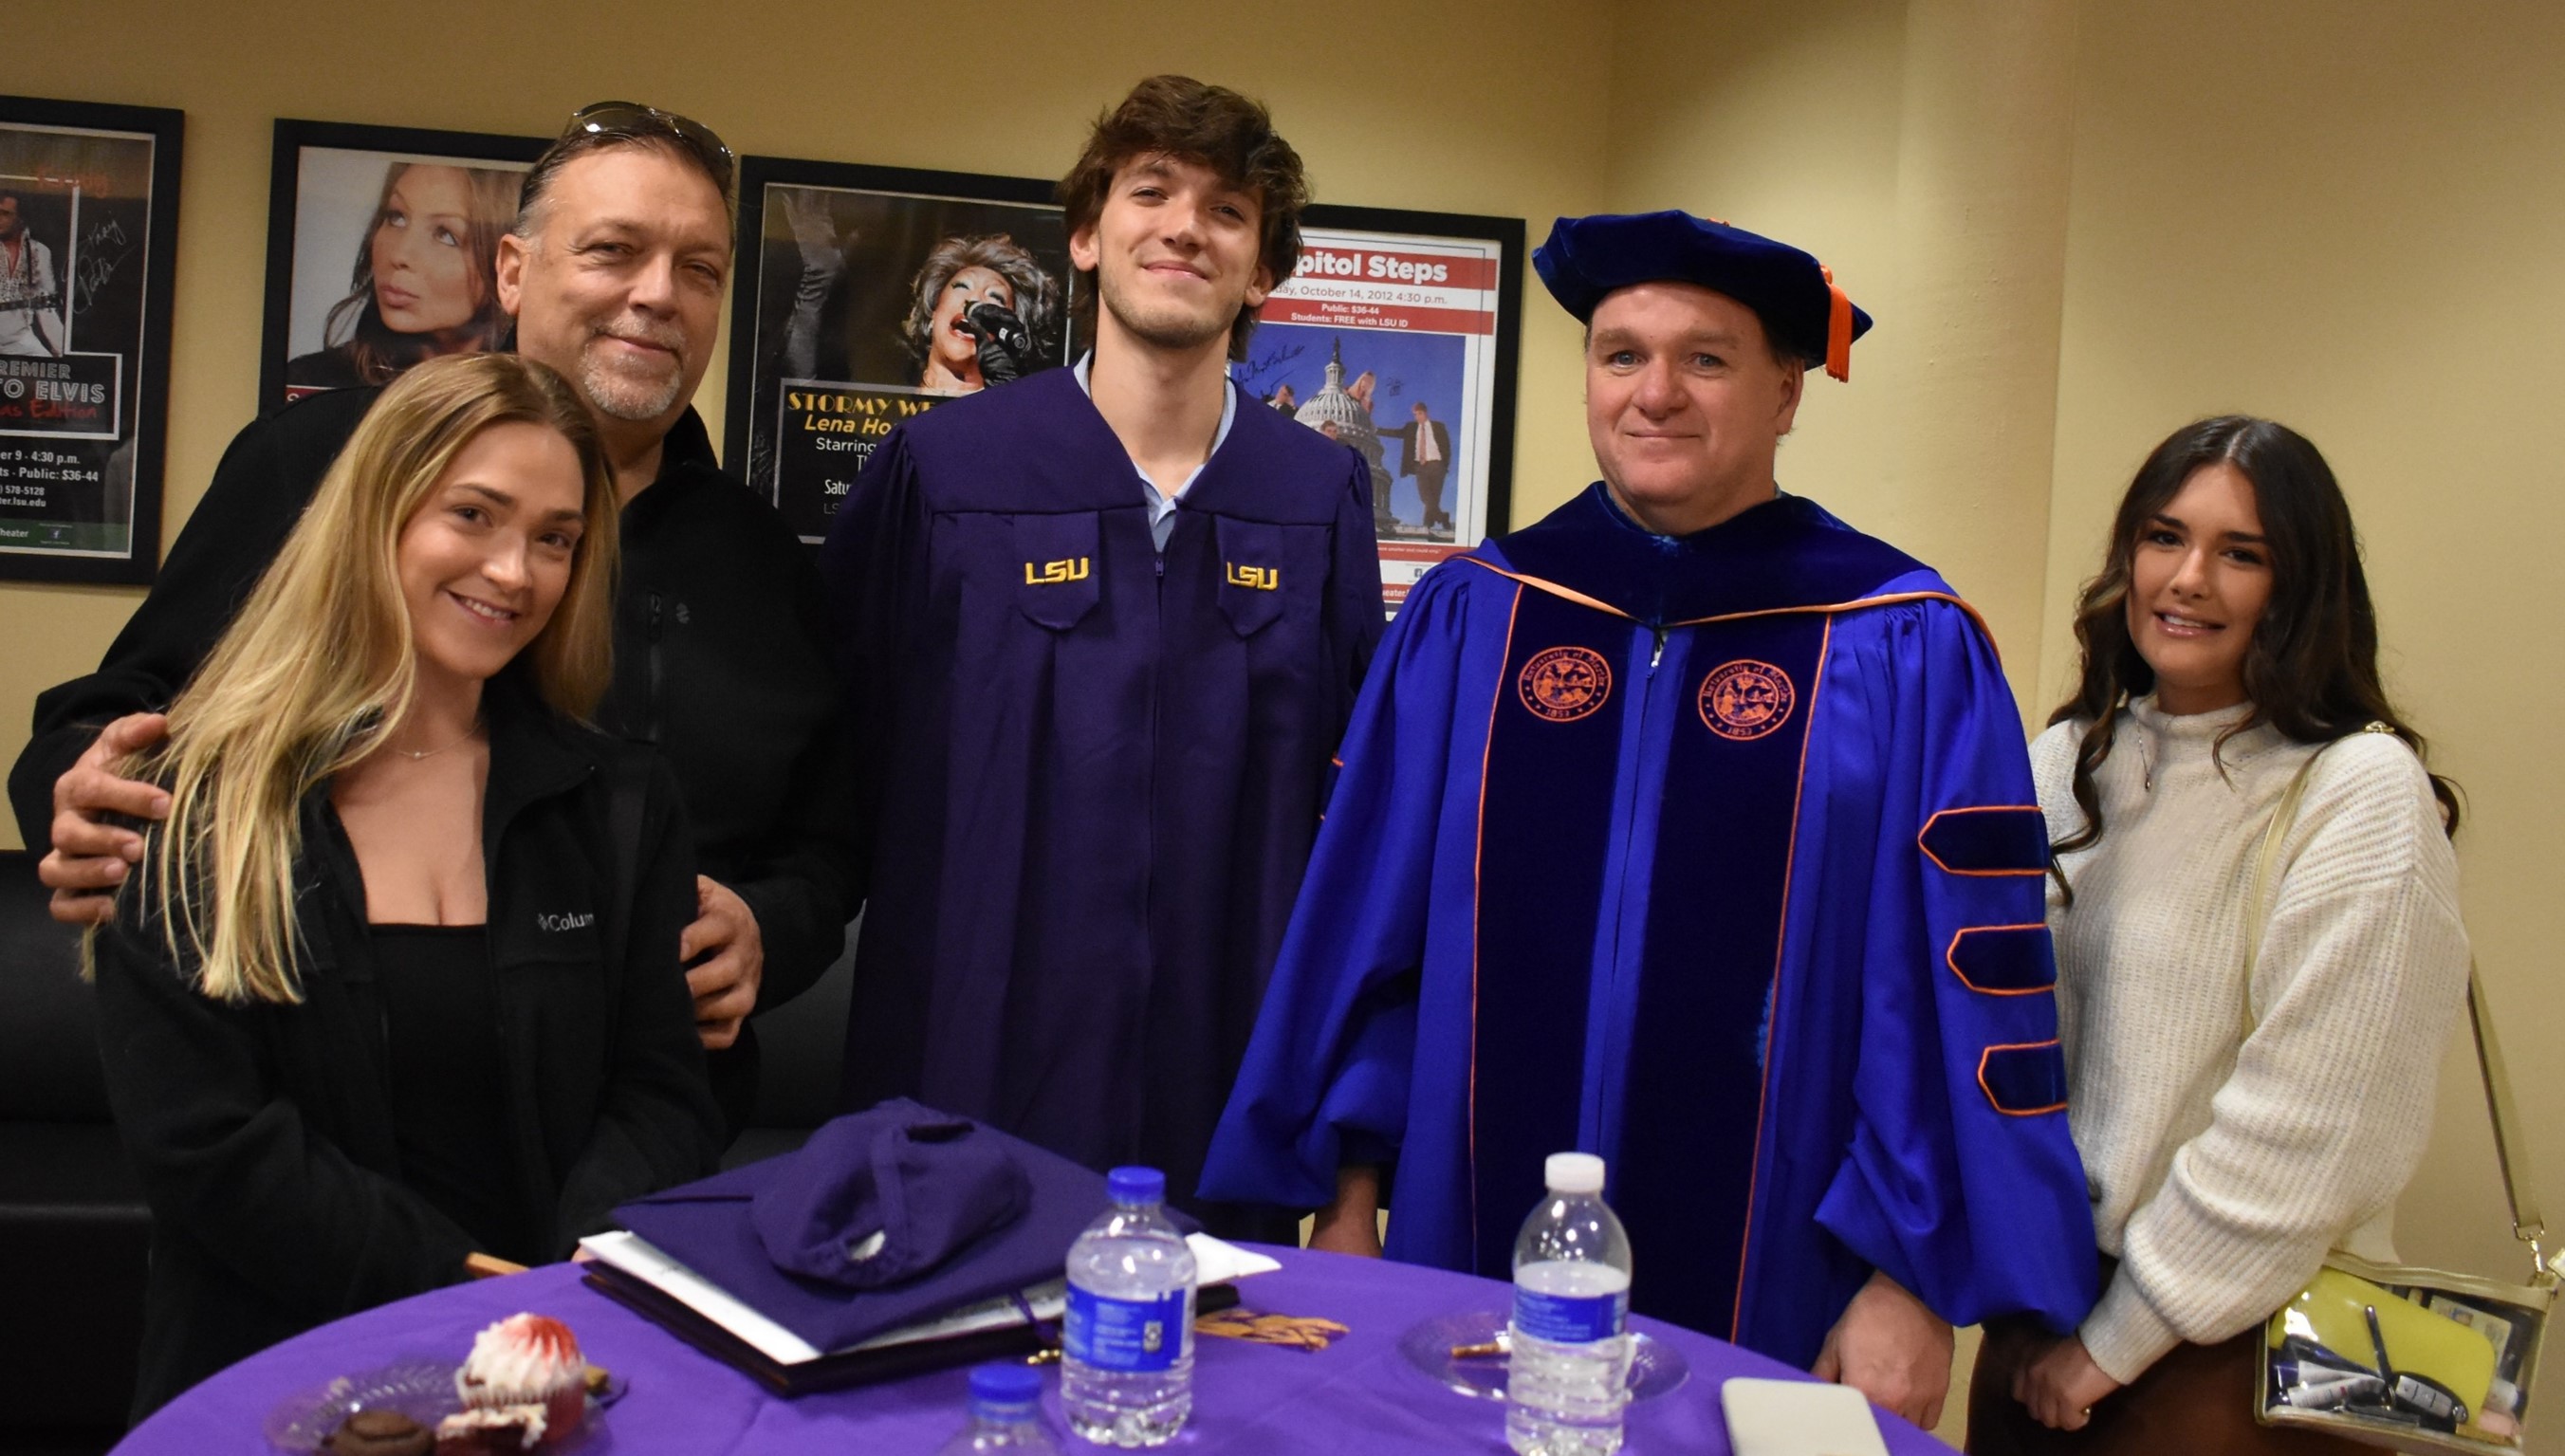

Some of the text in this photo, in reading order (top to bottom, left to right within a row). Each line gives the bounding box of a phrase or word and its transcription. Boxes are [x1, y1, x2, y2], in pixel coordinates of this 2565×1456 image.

[1292, 250, 1449, 286] pitol Steps
[1301, 286, 1347, 298] October
[1349, 289, 1365, 300] 14,
[1367, 289, 1393, 301] 2012
[1395, 292, 1422, 303] 4:30
[1424, 296, 1448, 304] p.m.
[1321, 304, 1380, 315] Public: $36-44
[1290, 312, 1409, 328] Students: FREE with LSU ID
[35, 380, 105, 404] ELVIS
[788, 392, 892, 415] STORMY
[804, 414, 897, 435] Lena Ho
[14, 450, 23, 461] 9
[30, 451, 54, 463] 4:30
[56, 454, 81, 466] p.m.
[19, 467, 59, 480] Public:
[62, 470, 99, 482] $36-44
[5, 485, 46, 496] 578-5128
[1024, 557, 1090, 585] LSU
[1226, 562, 1279, 591] LSU
